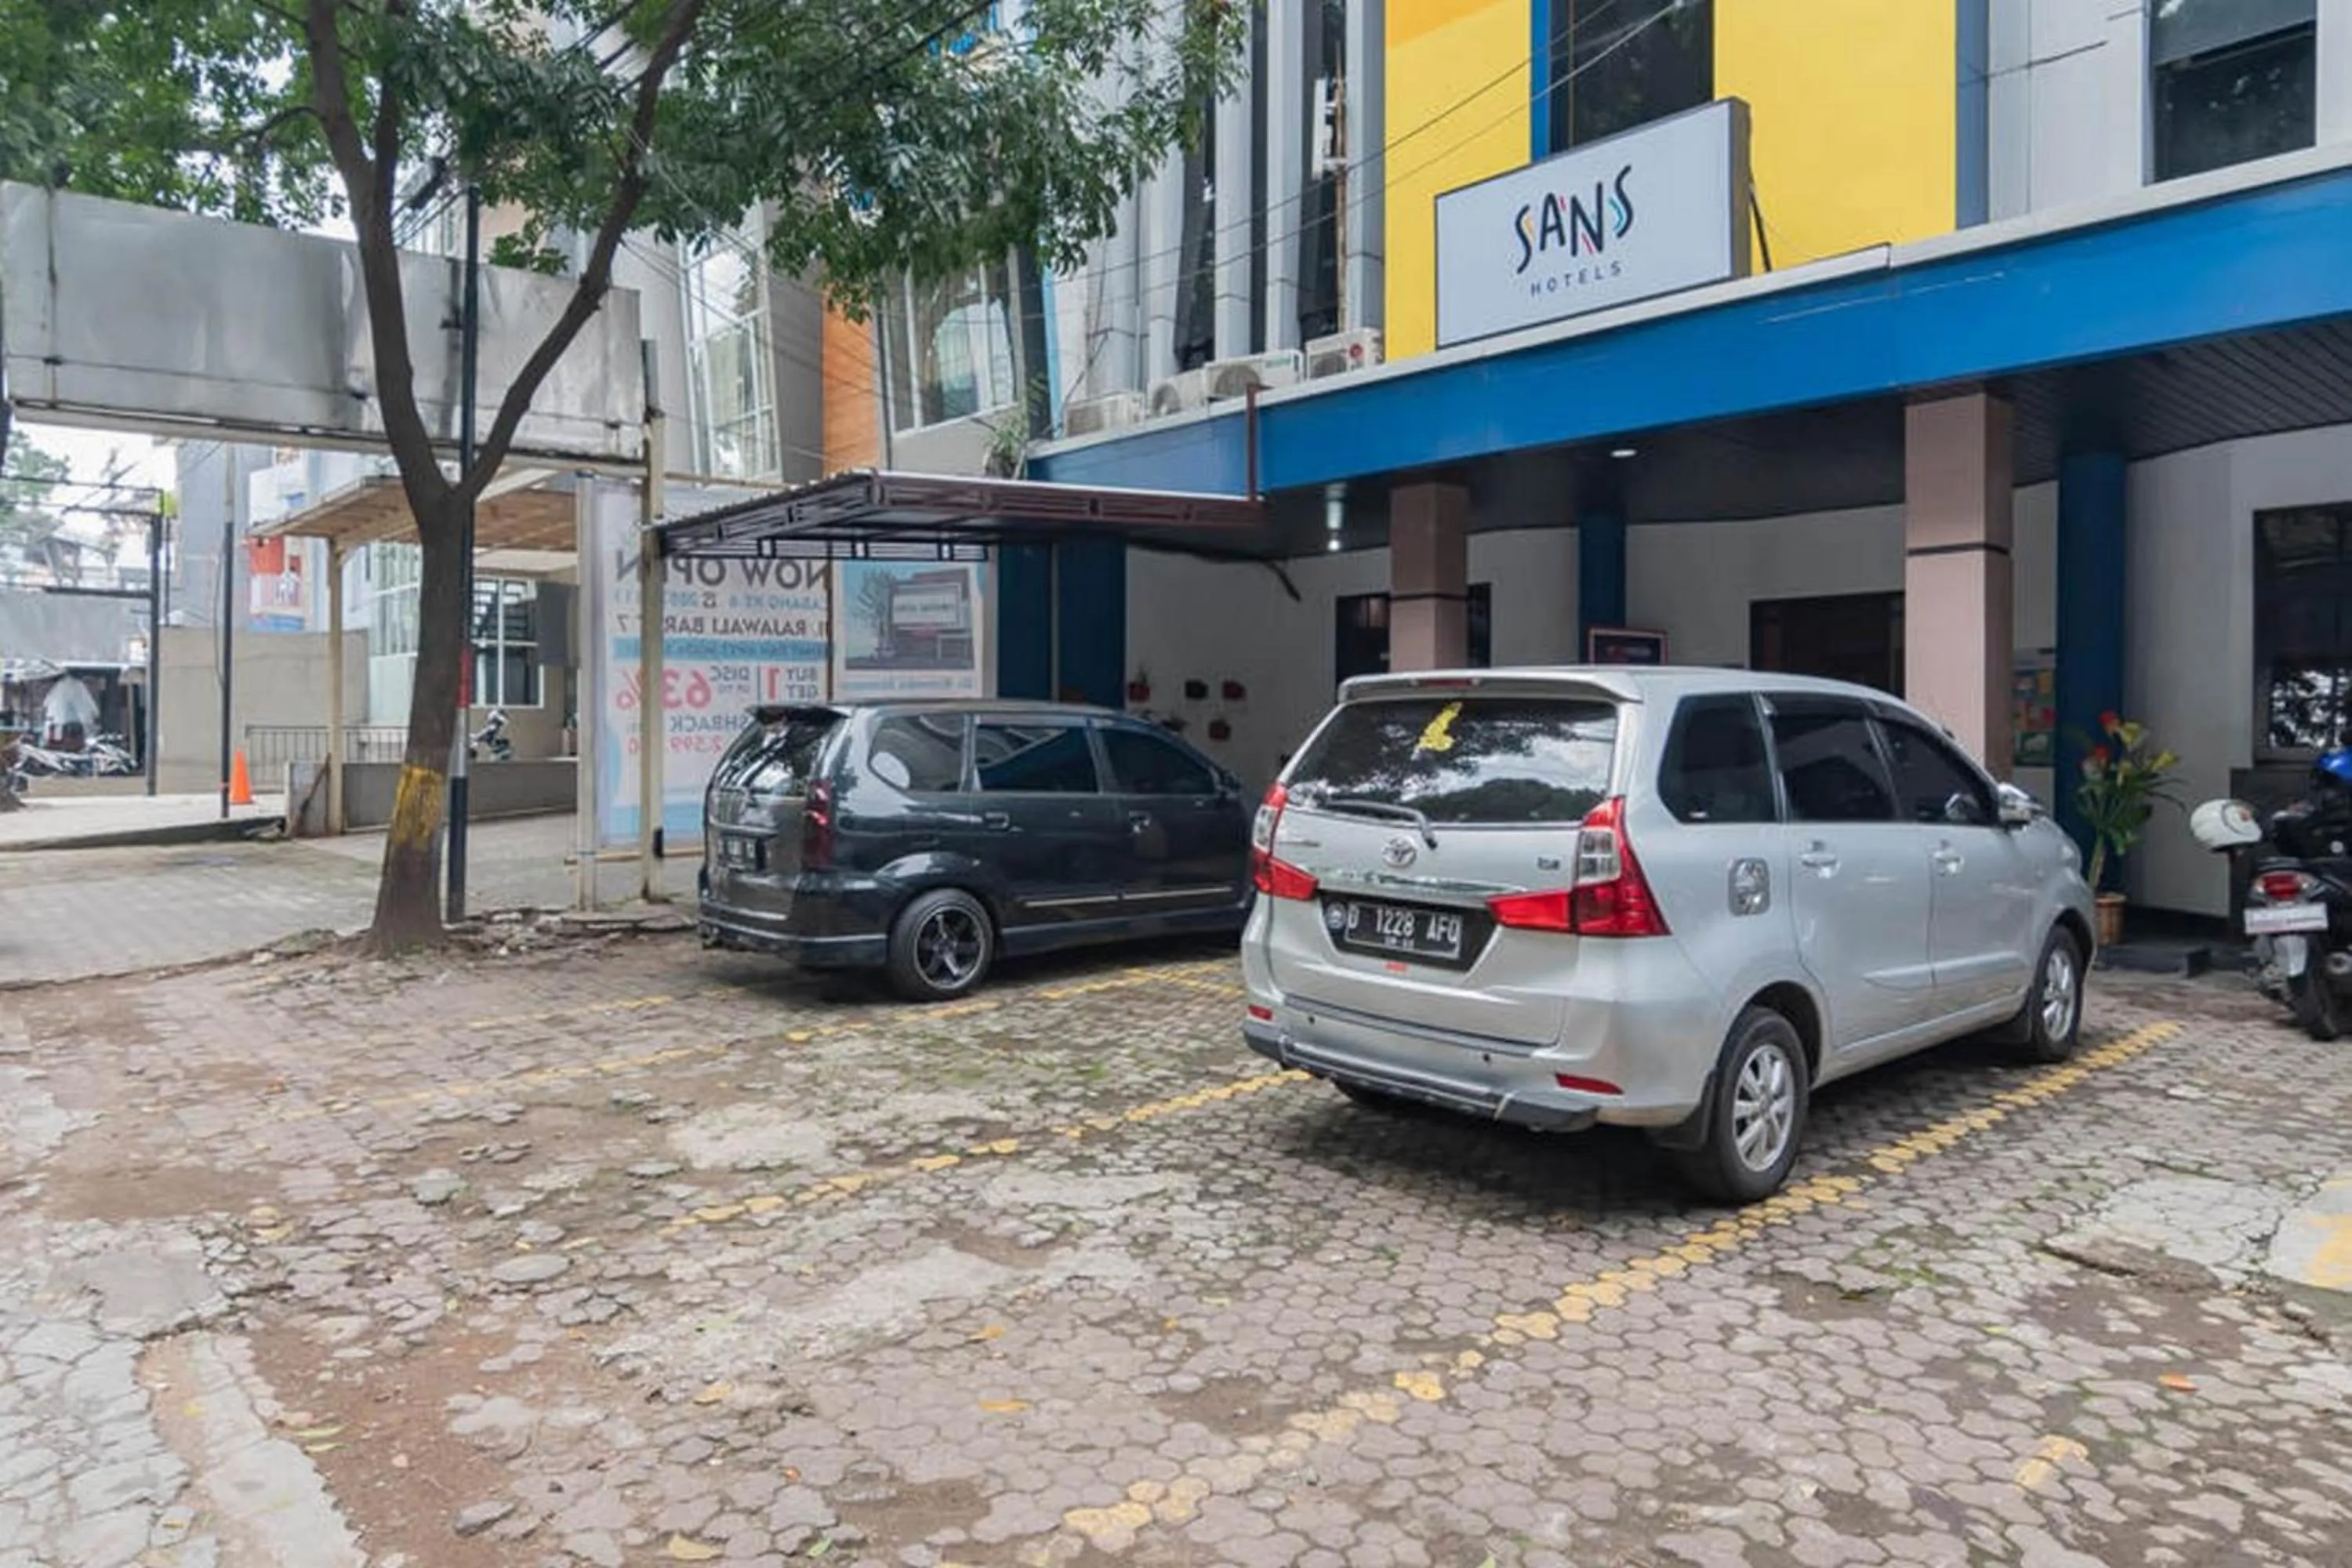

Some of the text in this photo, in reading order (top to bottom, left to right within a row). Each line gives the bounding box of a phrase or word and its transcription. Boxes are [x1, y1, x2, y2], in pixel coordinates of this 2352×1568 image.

[1515, 165, 1633, 274] SANS
[1531, 260, 1621, 297] HOTELS
[1376, 906, 1415, 936] 1228
